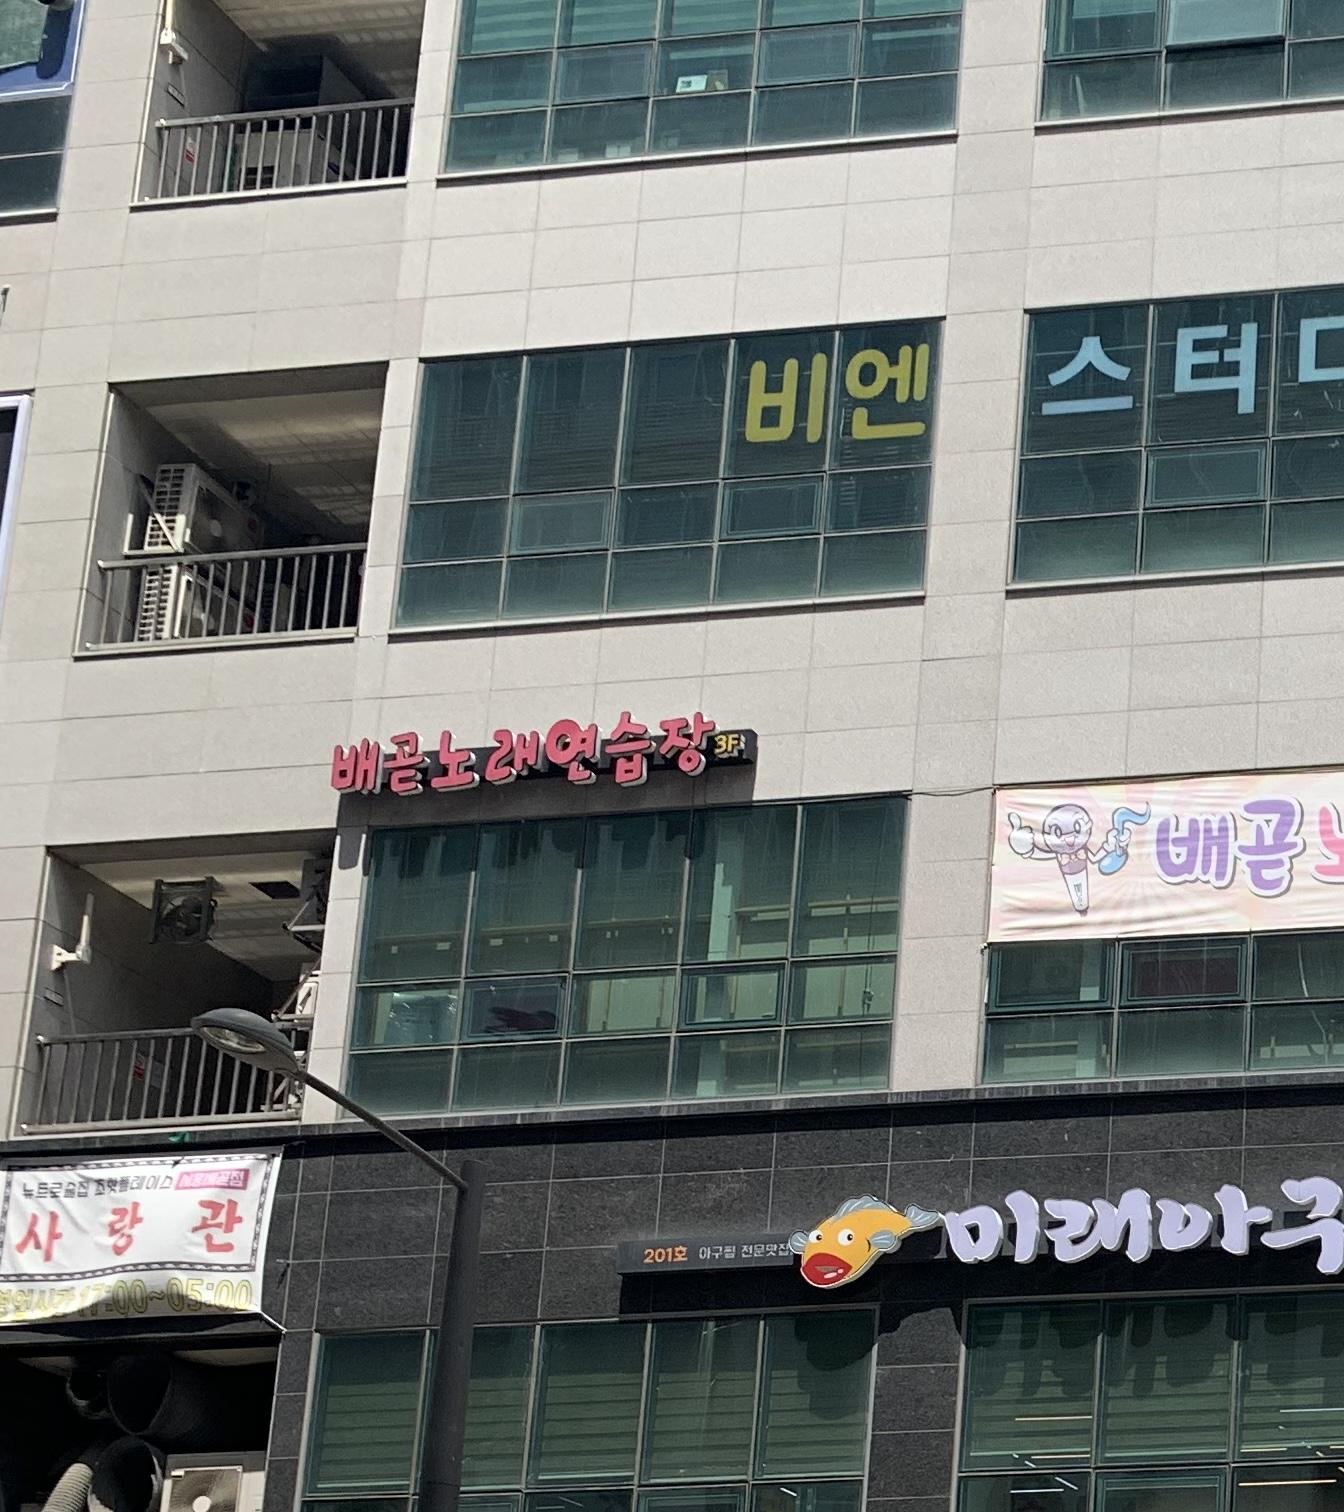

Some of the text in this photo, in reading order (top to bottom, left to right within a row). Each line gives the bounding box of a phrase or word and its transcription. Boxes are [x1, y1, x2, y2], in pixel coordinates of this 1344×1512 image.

[744, 341, 930, 444] 비엔
[331, 711, 743, 794] 배곧노래연습장 3F
[1154, 797, 1306, 895] 배곧
[643, 1245, 689, 1264] 201호
